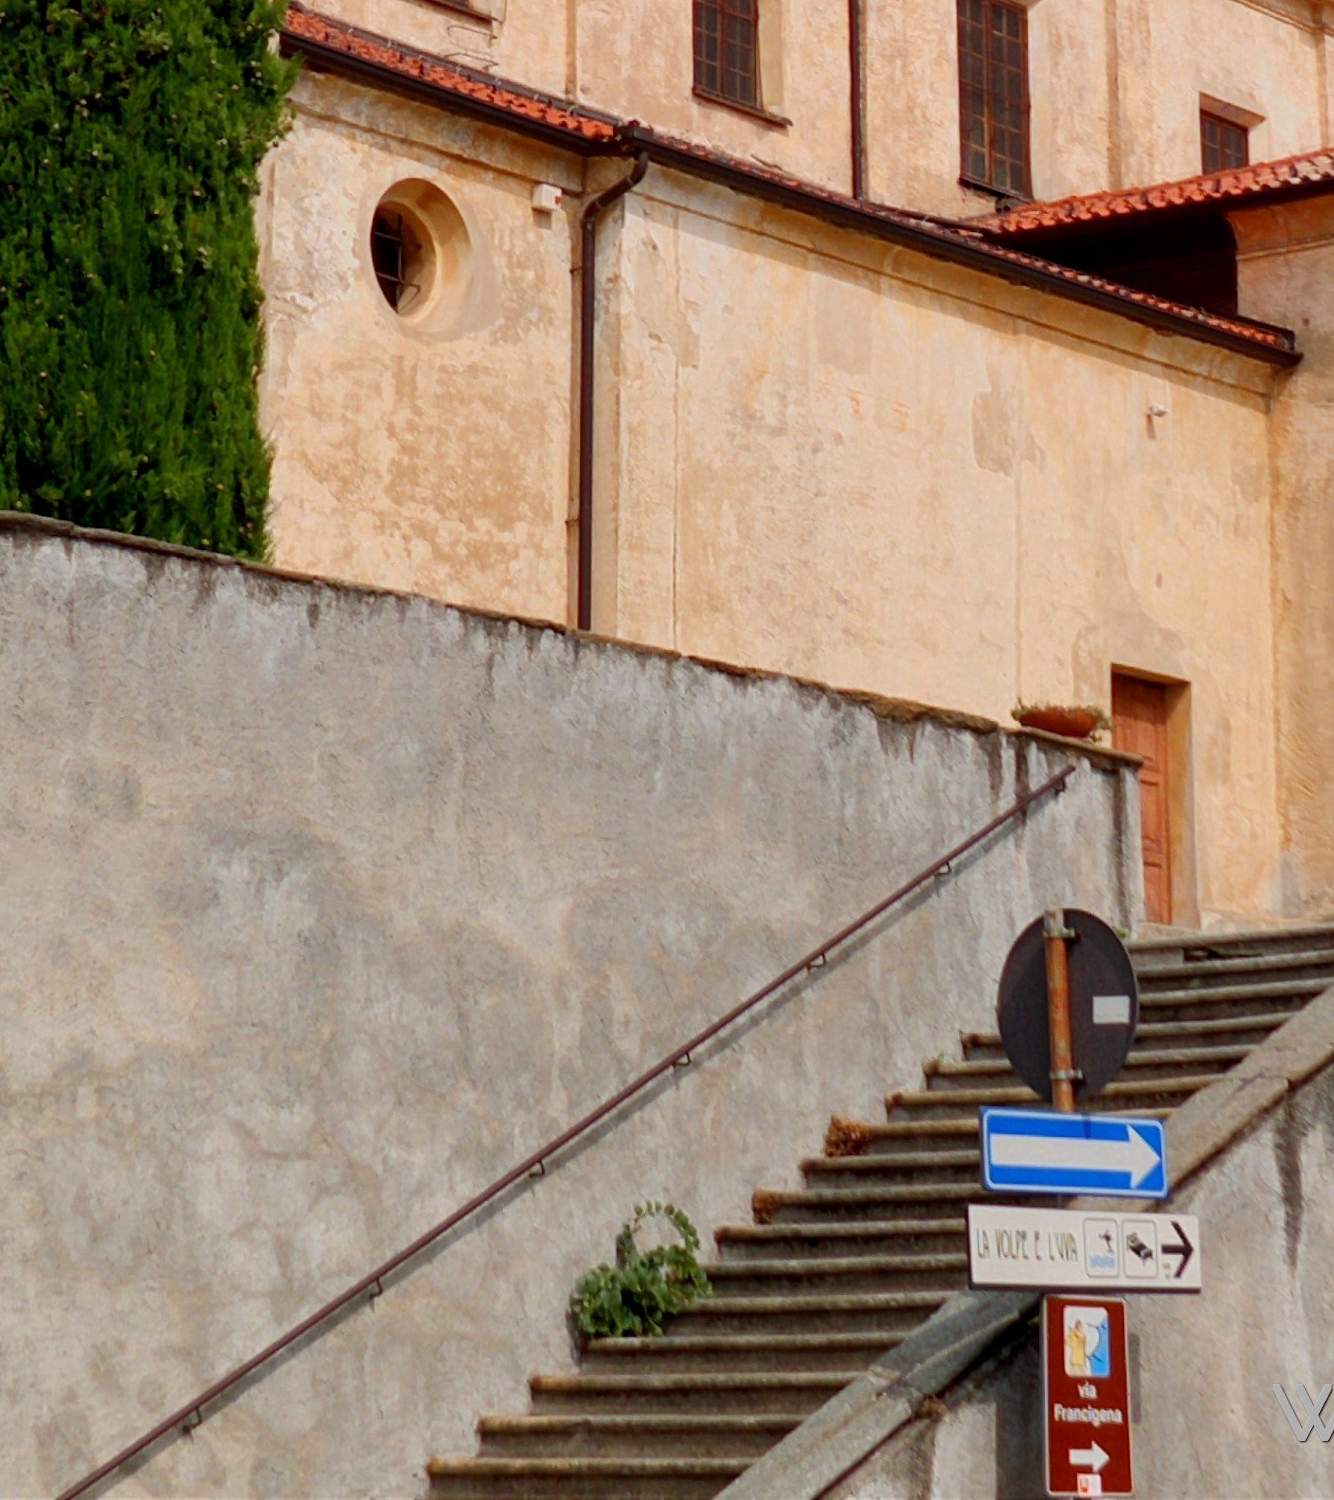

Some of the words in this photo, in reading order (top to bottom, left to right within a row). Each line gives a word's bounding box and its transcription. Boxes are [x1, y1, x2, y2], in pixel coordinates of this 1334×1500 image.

[976, 1229, 990, 1258] LA
[994, 1229, 1029, 1260] VOLPE
[1033, 1230, 1042, 1261] E
[1077, 1381, 1098, 1399] via
[1053, 1403, 1123, 1428] Francigena
